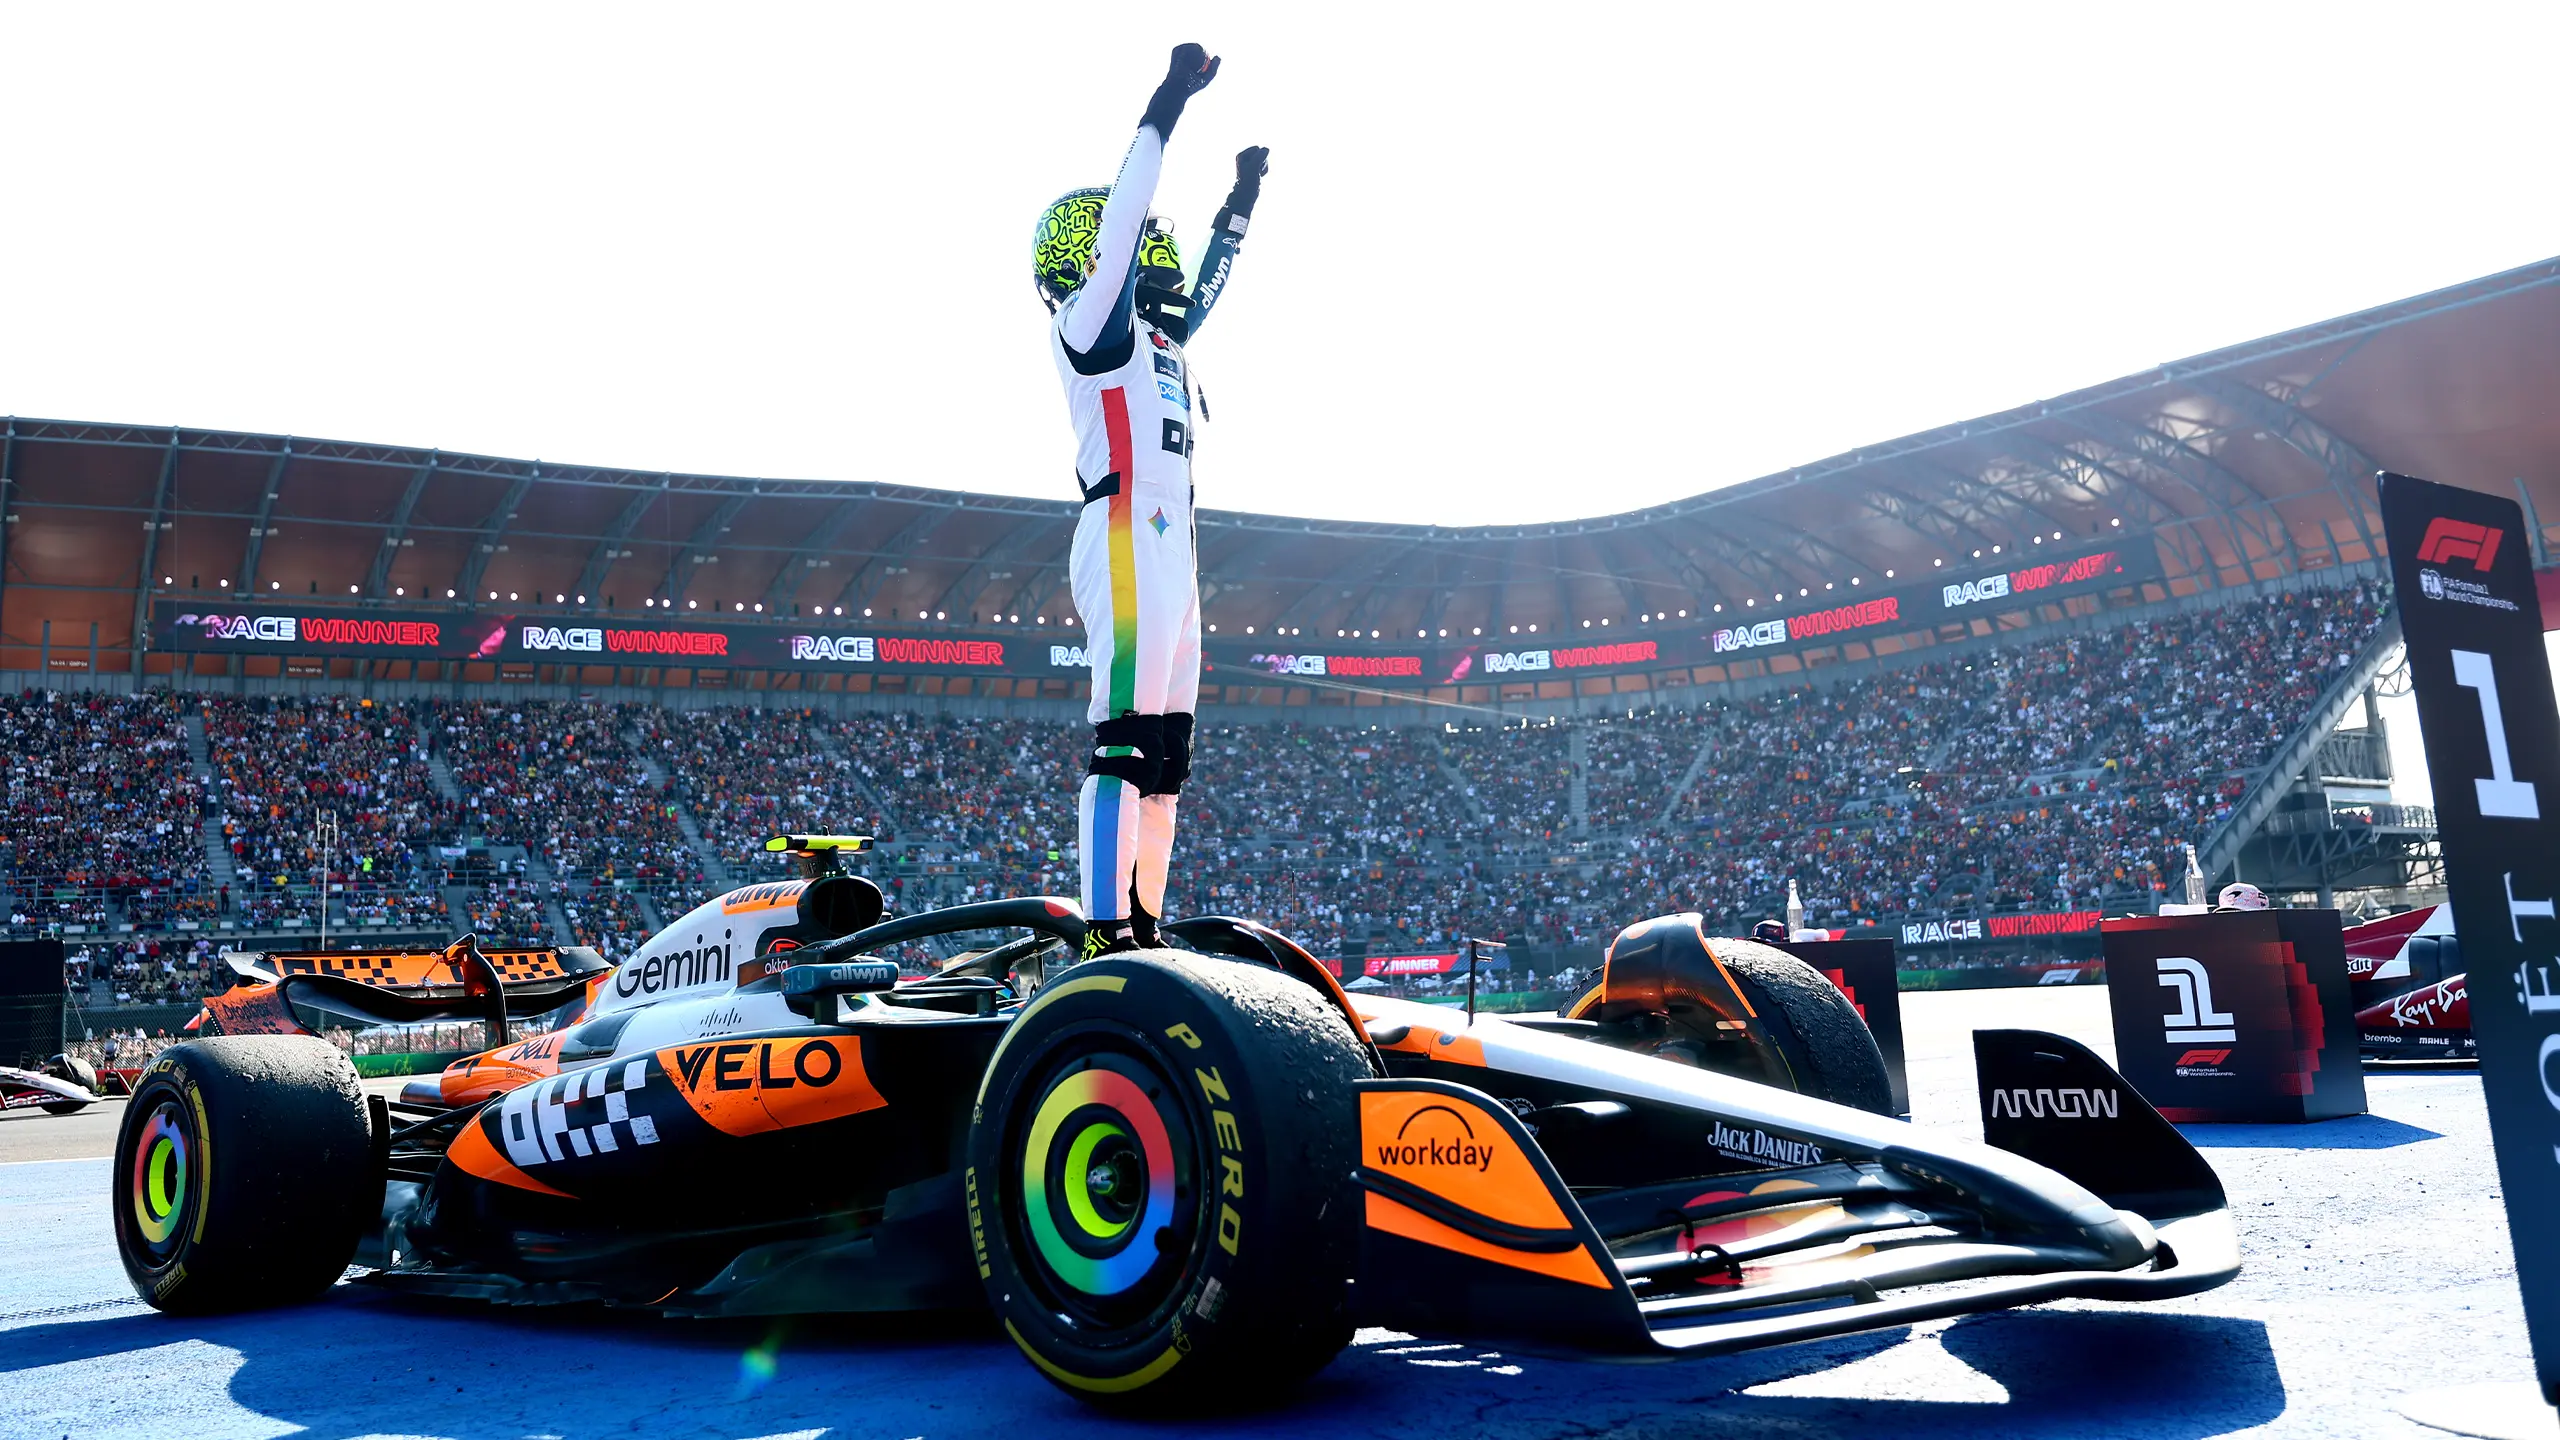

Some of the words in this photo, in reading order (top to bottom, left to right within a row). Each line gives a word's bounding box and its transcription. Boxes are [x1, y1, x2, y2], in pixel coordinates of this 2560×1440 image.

[1199, 256, 1230, 309] allwyn
[1942, 573, 2009, 608] RACE
[2445, 590, 2467, 603] World
[2454, 580, 2484, 593] Formula
[204, 614, 296, 641] RACE
[301, 617, 440, 647] WINNER
[1712, 619, 1787, 653] RACE
[1787, 596, 1900, 641] WINNER
[522, 626, 603, 652] RACE
[605, 629, 728, 656] WINNER
[791, 635, 874, 662] RACE
[877, 637, 1004, 666] WINNER
[1326, 655, 1422, 677] WINNER
[1484, 649, 1551, 674] RACE
[1552, 641, 1658, 669] WINNER
[2450, 648, 2541, 820] 1
[725, 883, 804, 906] allwyn
[1901, 918, 1982, 945] RACE
[615, 928, 732, 998] Gemini
[764, 957, 789, 975] okta
[830, 964, 888, 983] allwyn
[2156, 956, 2237, 1043] 1
[508, 1036, 556, 1062] DELL
[2364, 1033, 2402, 1043] brembo
[2418, 1037, 2450, 1045] MAHLE
[505, 1065, 543, 1079] Technologies
[676, 1039, 842, 1094] VELO
[1991, 1088, 2118, 1118] ARROW
[1165, 1022, 1202, 1050] P
[1194, 1066, 1244, 1257] ZERO
[1378, 1138, 1494, 1172] workday
[1707, 1120, 1751, 1153] JACK
[1753, 1129, 1822, 1165] DANIEL'S
[966, 1166, 991, 1280] PIRELLI
[153, 1261, 189, 1301] PIRELLI
